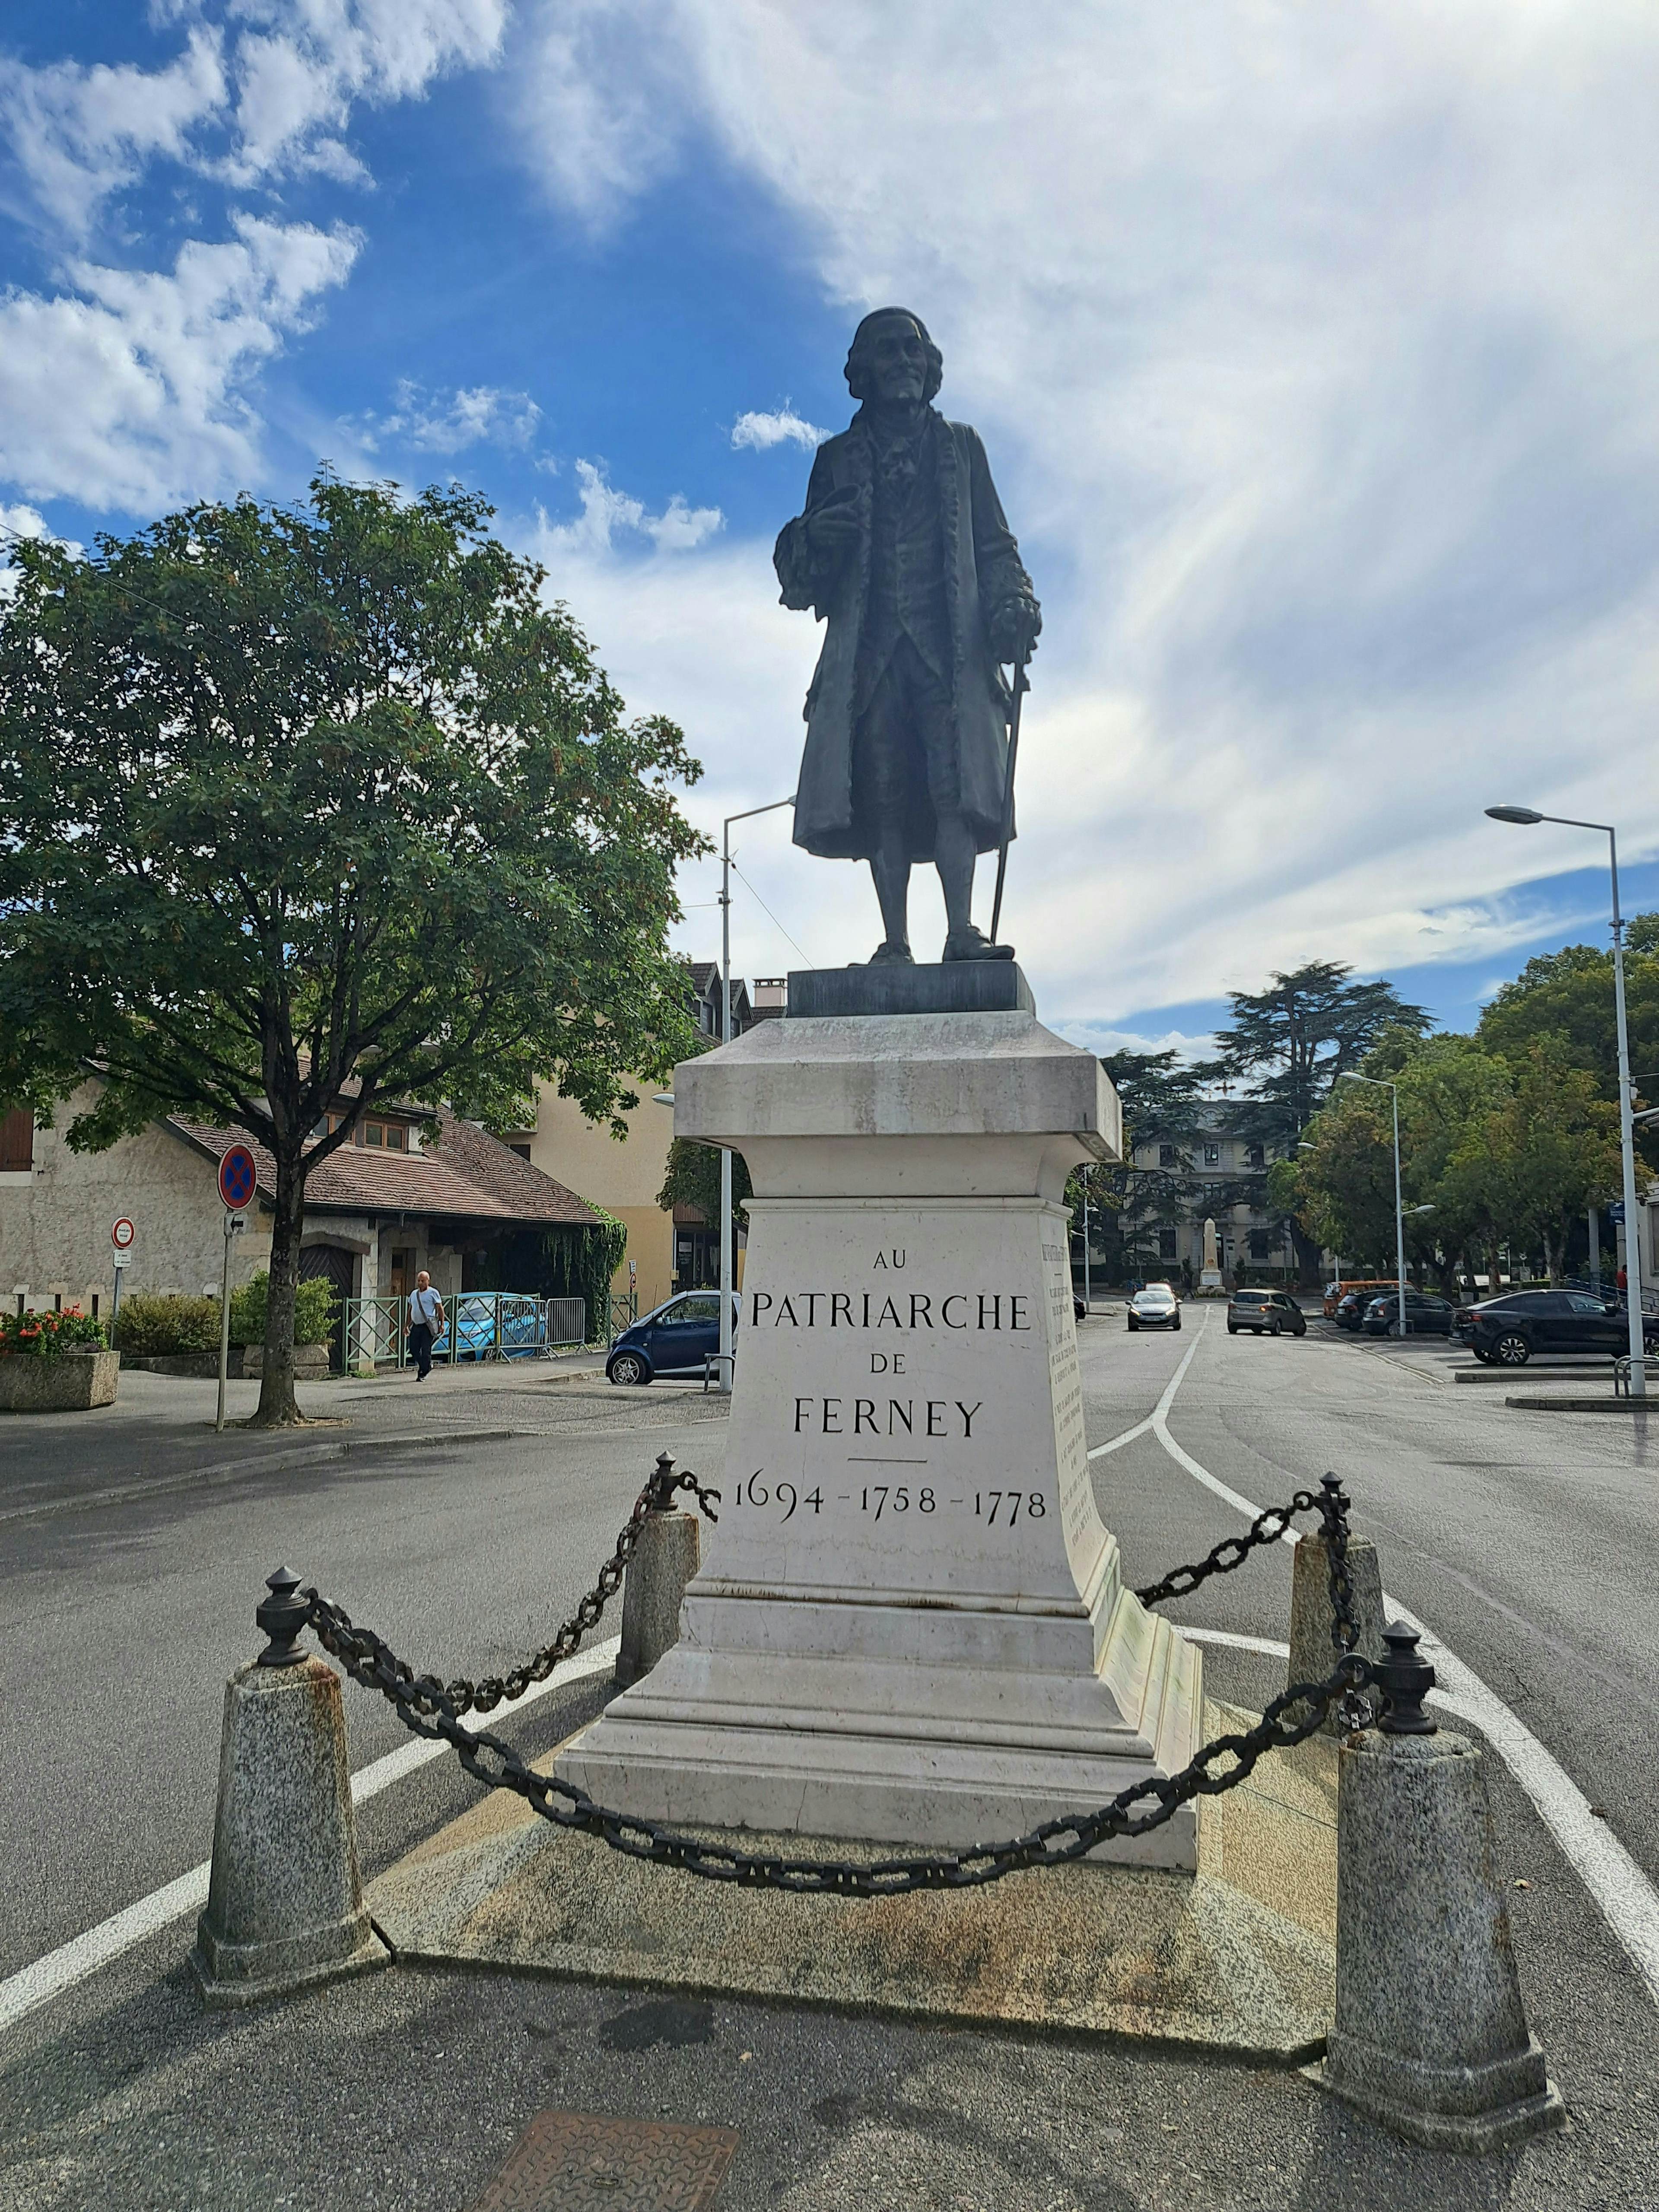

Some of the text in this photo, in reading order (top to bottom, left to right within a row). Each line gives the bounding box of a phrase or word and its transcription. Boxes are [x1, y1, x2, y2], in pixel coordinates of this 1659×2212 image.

[873, 1249, 906, 1269] AU
[751, 1292, 1031, 1331] PATRIARCHE
[870, 1353, 906, 1374] DE
[794, 1397, 984, 1438] FERNEY
